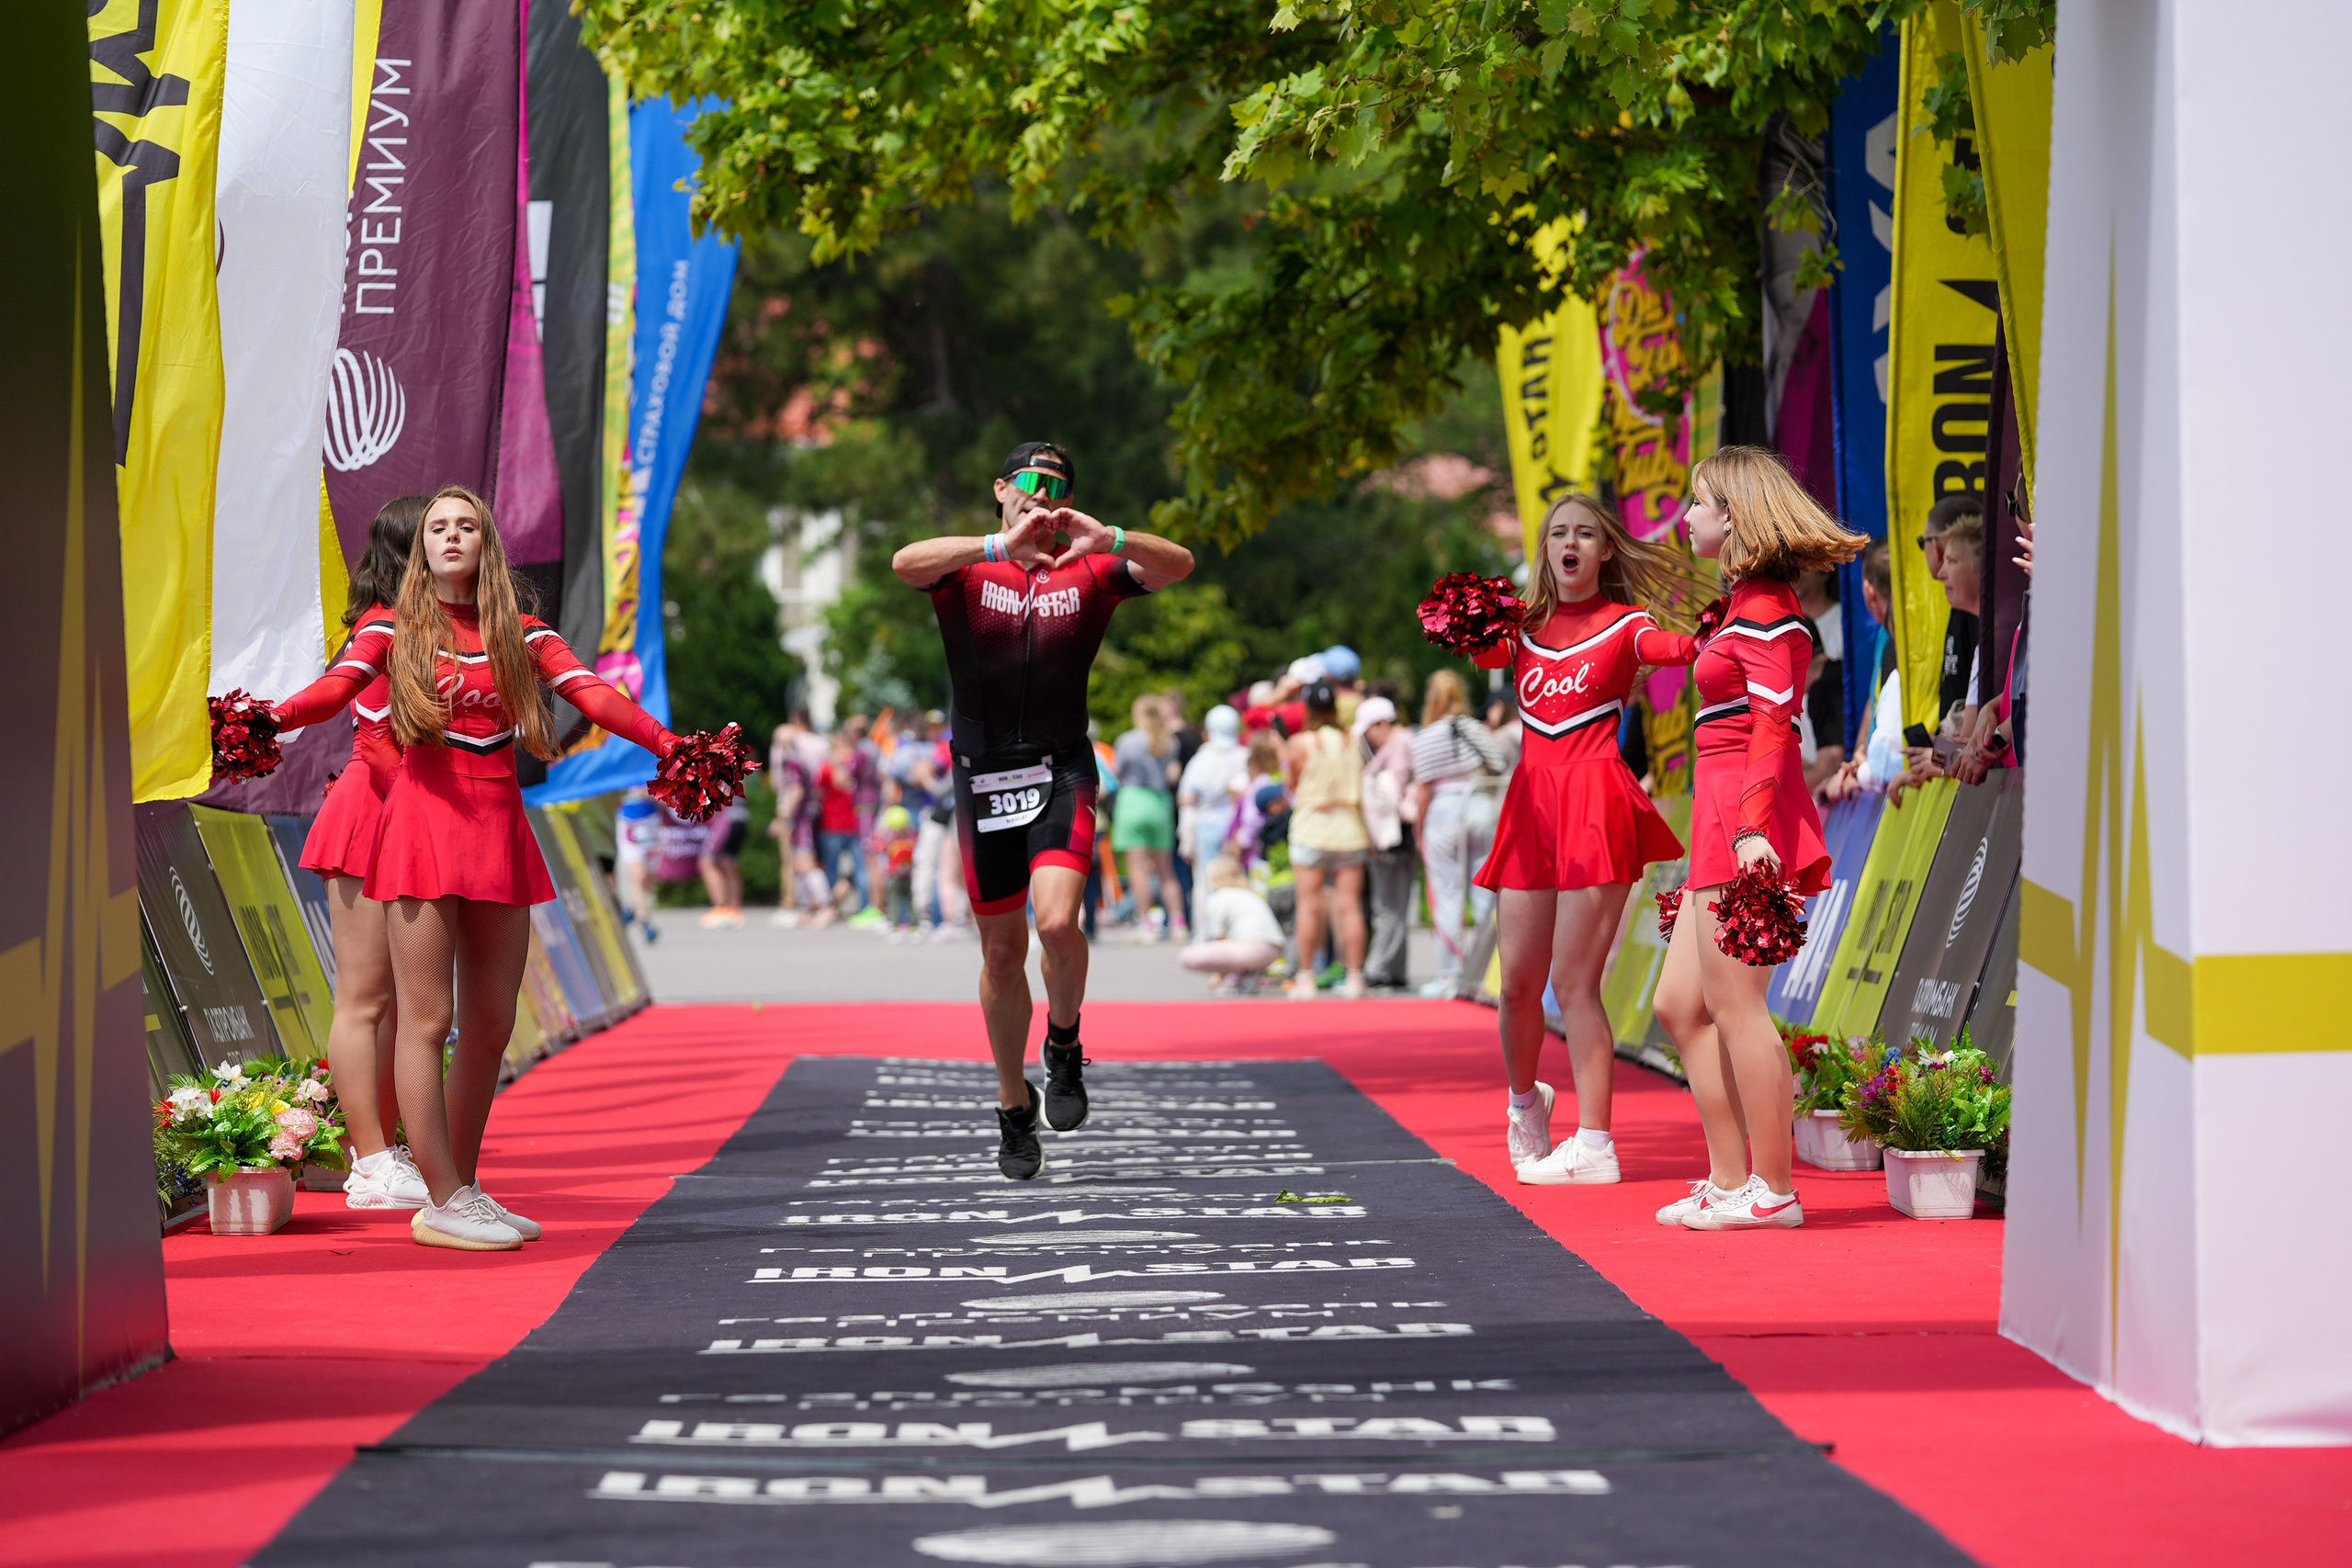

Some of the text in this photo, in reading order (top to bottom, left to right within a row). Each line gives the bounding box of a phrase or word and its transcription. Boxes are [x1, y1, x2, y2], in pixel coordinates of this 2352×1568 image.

[355, 58, 413, 314] ПРЕМИУМ
[665, 259, 690, 321] ДОМ
[980, 580, 1081, 617] IRON STAR
[1519, 662, 1590, 708] Cool
[989, 787, 1041, 816] 3019
[786, 1205, 1368, 1224] IRON STAR
[753, 1257, 1416, 1280] IRON STAR
[707, 1322, 1475, 1349] IRON STAR
[639, 1416, 1555, 1441] IRON STAR
[598, 1470, 1611, 1497] IRON STAR
